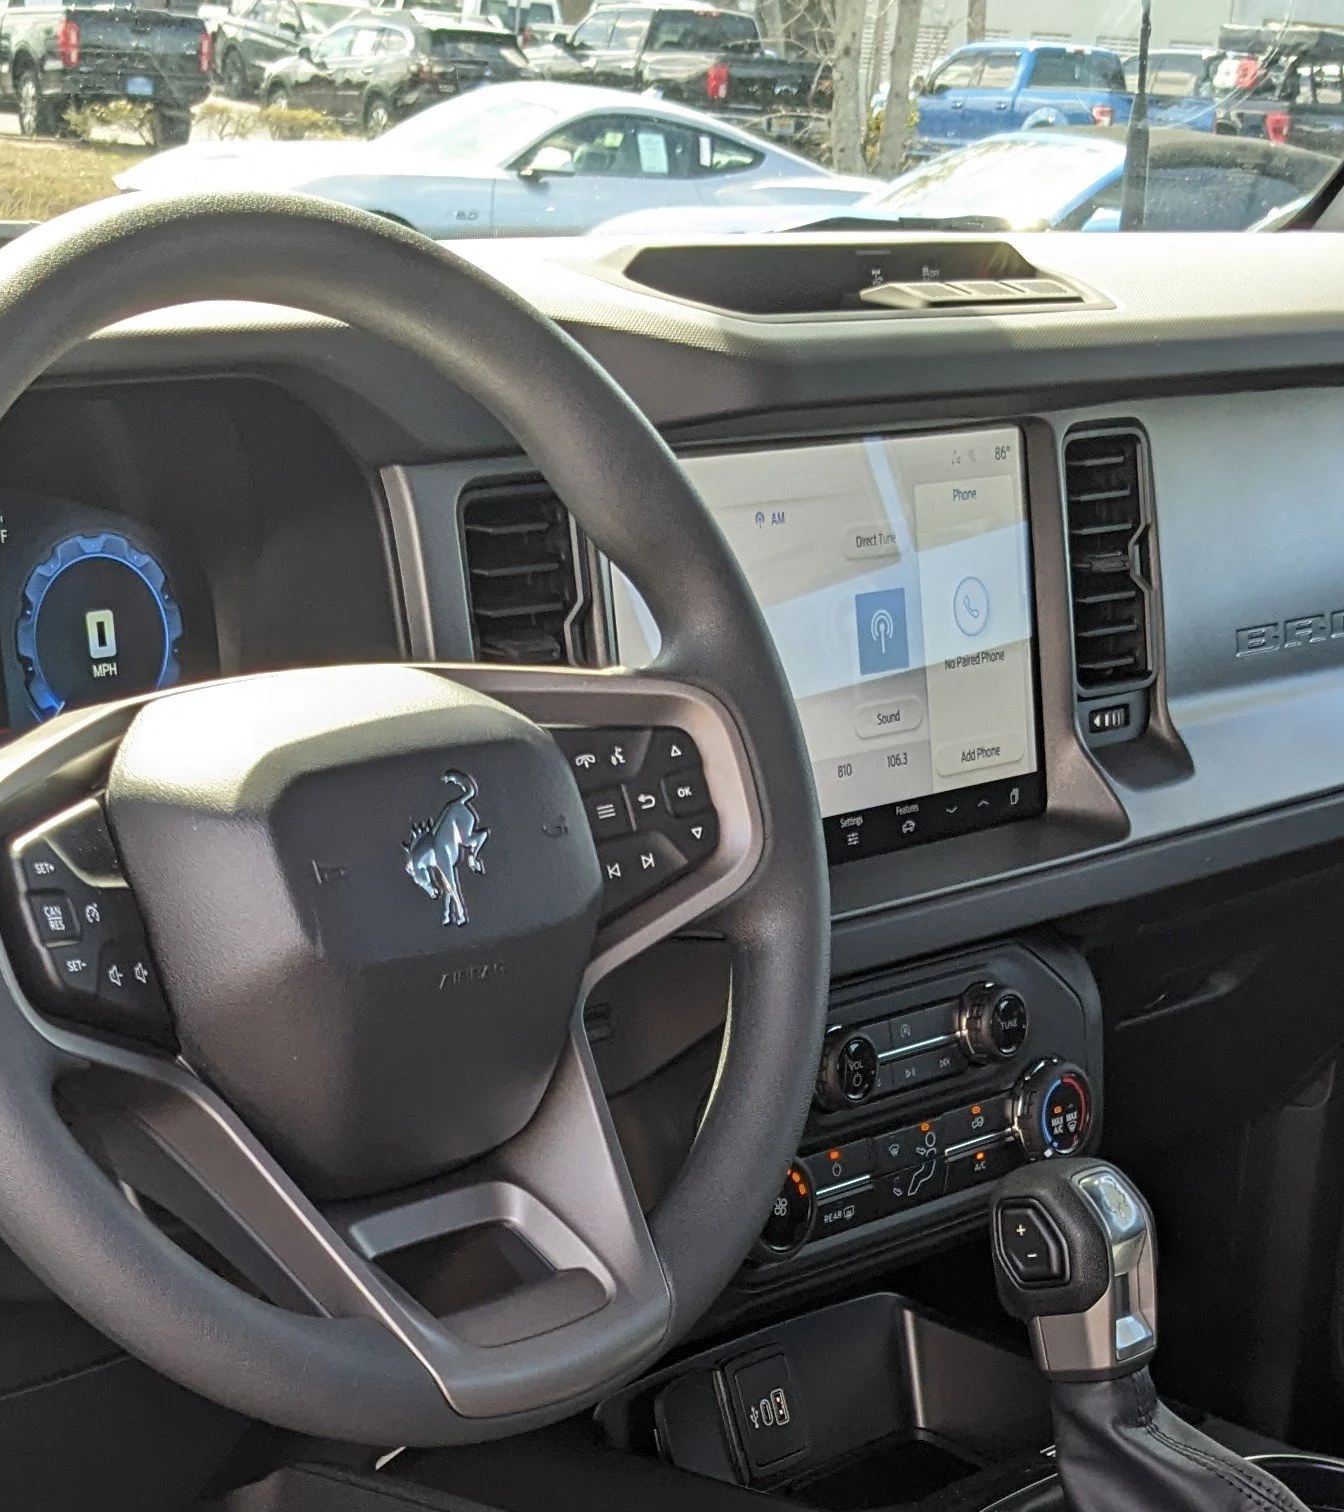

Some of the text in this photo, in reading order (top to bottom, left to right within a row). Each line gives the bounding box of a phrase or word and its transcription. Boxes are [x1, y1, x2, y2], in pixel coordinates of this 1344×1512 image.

[952, 487, 977, 502] Phone
[771, 512, 785, 526] AM
[0, 529, 8, 544] F
[856, 532, 896, 548] Direct Tune
[86, 609, 117, 659] 0
[945, 648, 1005, 670] No Paired Phone
[92, 662, 118, 678] MPH
[877, 710, 901, 725] Sound
[887, 752, 908, 768] 106.3
[961, 745, 1001, 762] Add Phone
[838, 763, 852, 778] 810
[678, 786, 692, 798] OK
[895, 804, 919, 816] Features
[43, 906, 62, 916] CAN
[49, 920, 66, 931] RES
[823, 1210, 843, 1223] REAR
